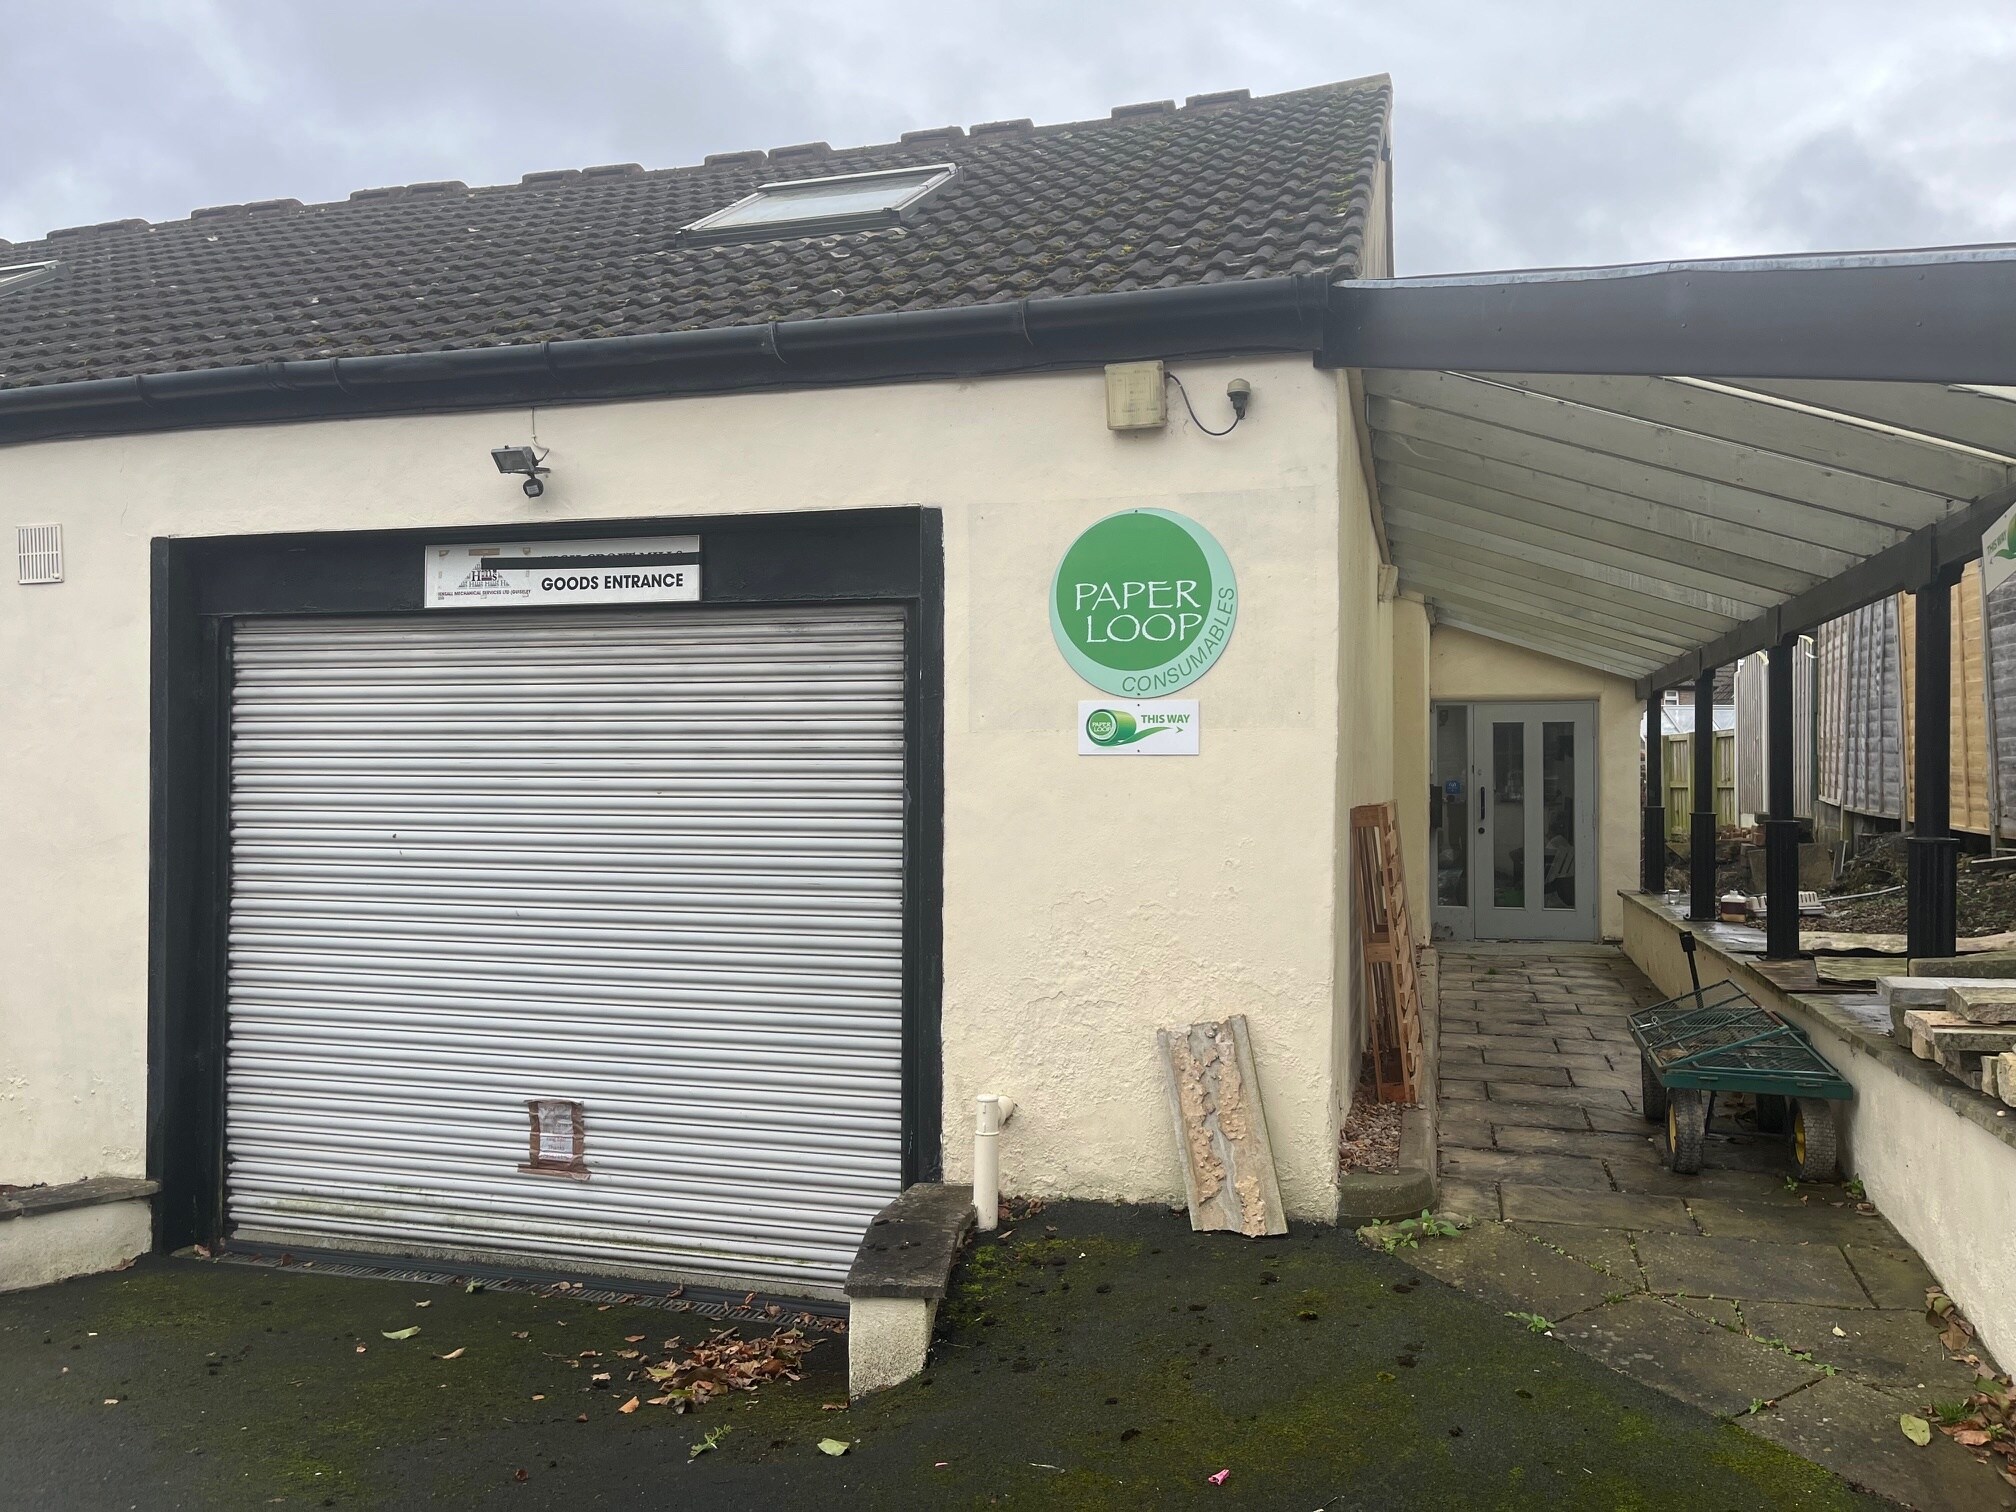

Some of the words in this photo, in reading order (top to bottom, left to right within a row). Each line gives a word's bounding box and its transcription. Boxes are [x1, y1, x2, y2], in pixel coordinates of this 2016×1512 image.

[541, 575, 599, 591] GOODS
[604, 572, 684, 590] ENTRANCE
[1074, 580, 1201, 611] PAPER
[1086, 613, 1203, 643] LOOP
[1121, 587, 1235, 692] CONSUMABLES
[1140, 714, 1165, 724] THIS
[1166, 714, 1190, 724] WAY
